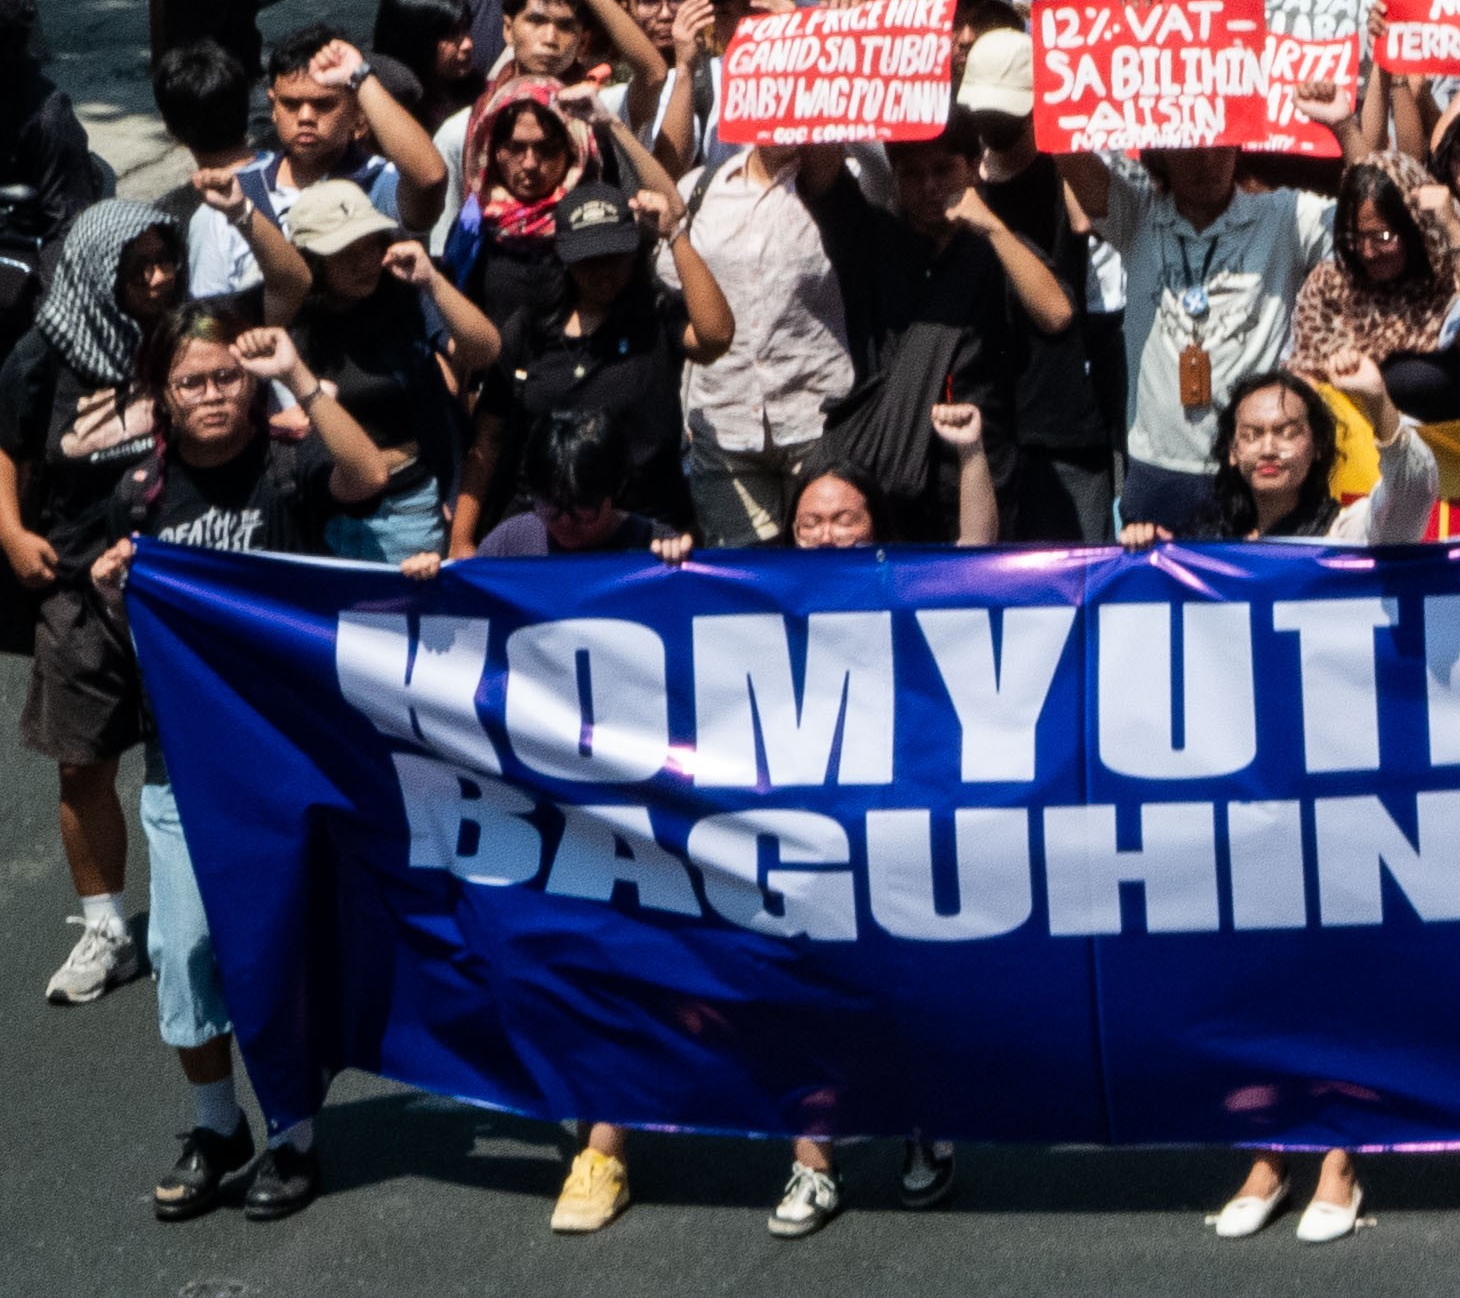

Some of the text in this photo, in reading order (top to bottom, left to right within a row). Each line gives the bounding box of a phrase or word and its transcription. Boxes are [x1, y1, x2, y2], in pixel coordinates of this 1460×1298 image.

[1042, 7, 1116, 51] 12%
[726, 34, 951, 79] GANID SA TUBO?
[1045, 44, 1268, 103] SA BILIHIN
[1088, 95, 1225, 135] ALISIN
